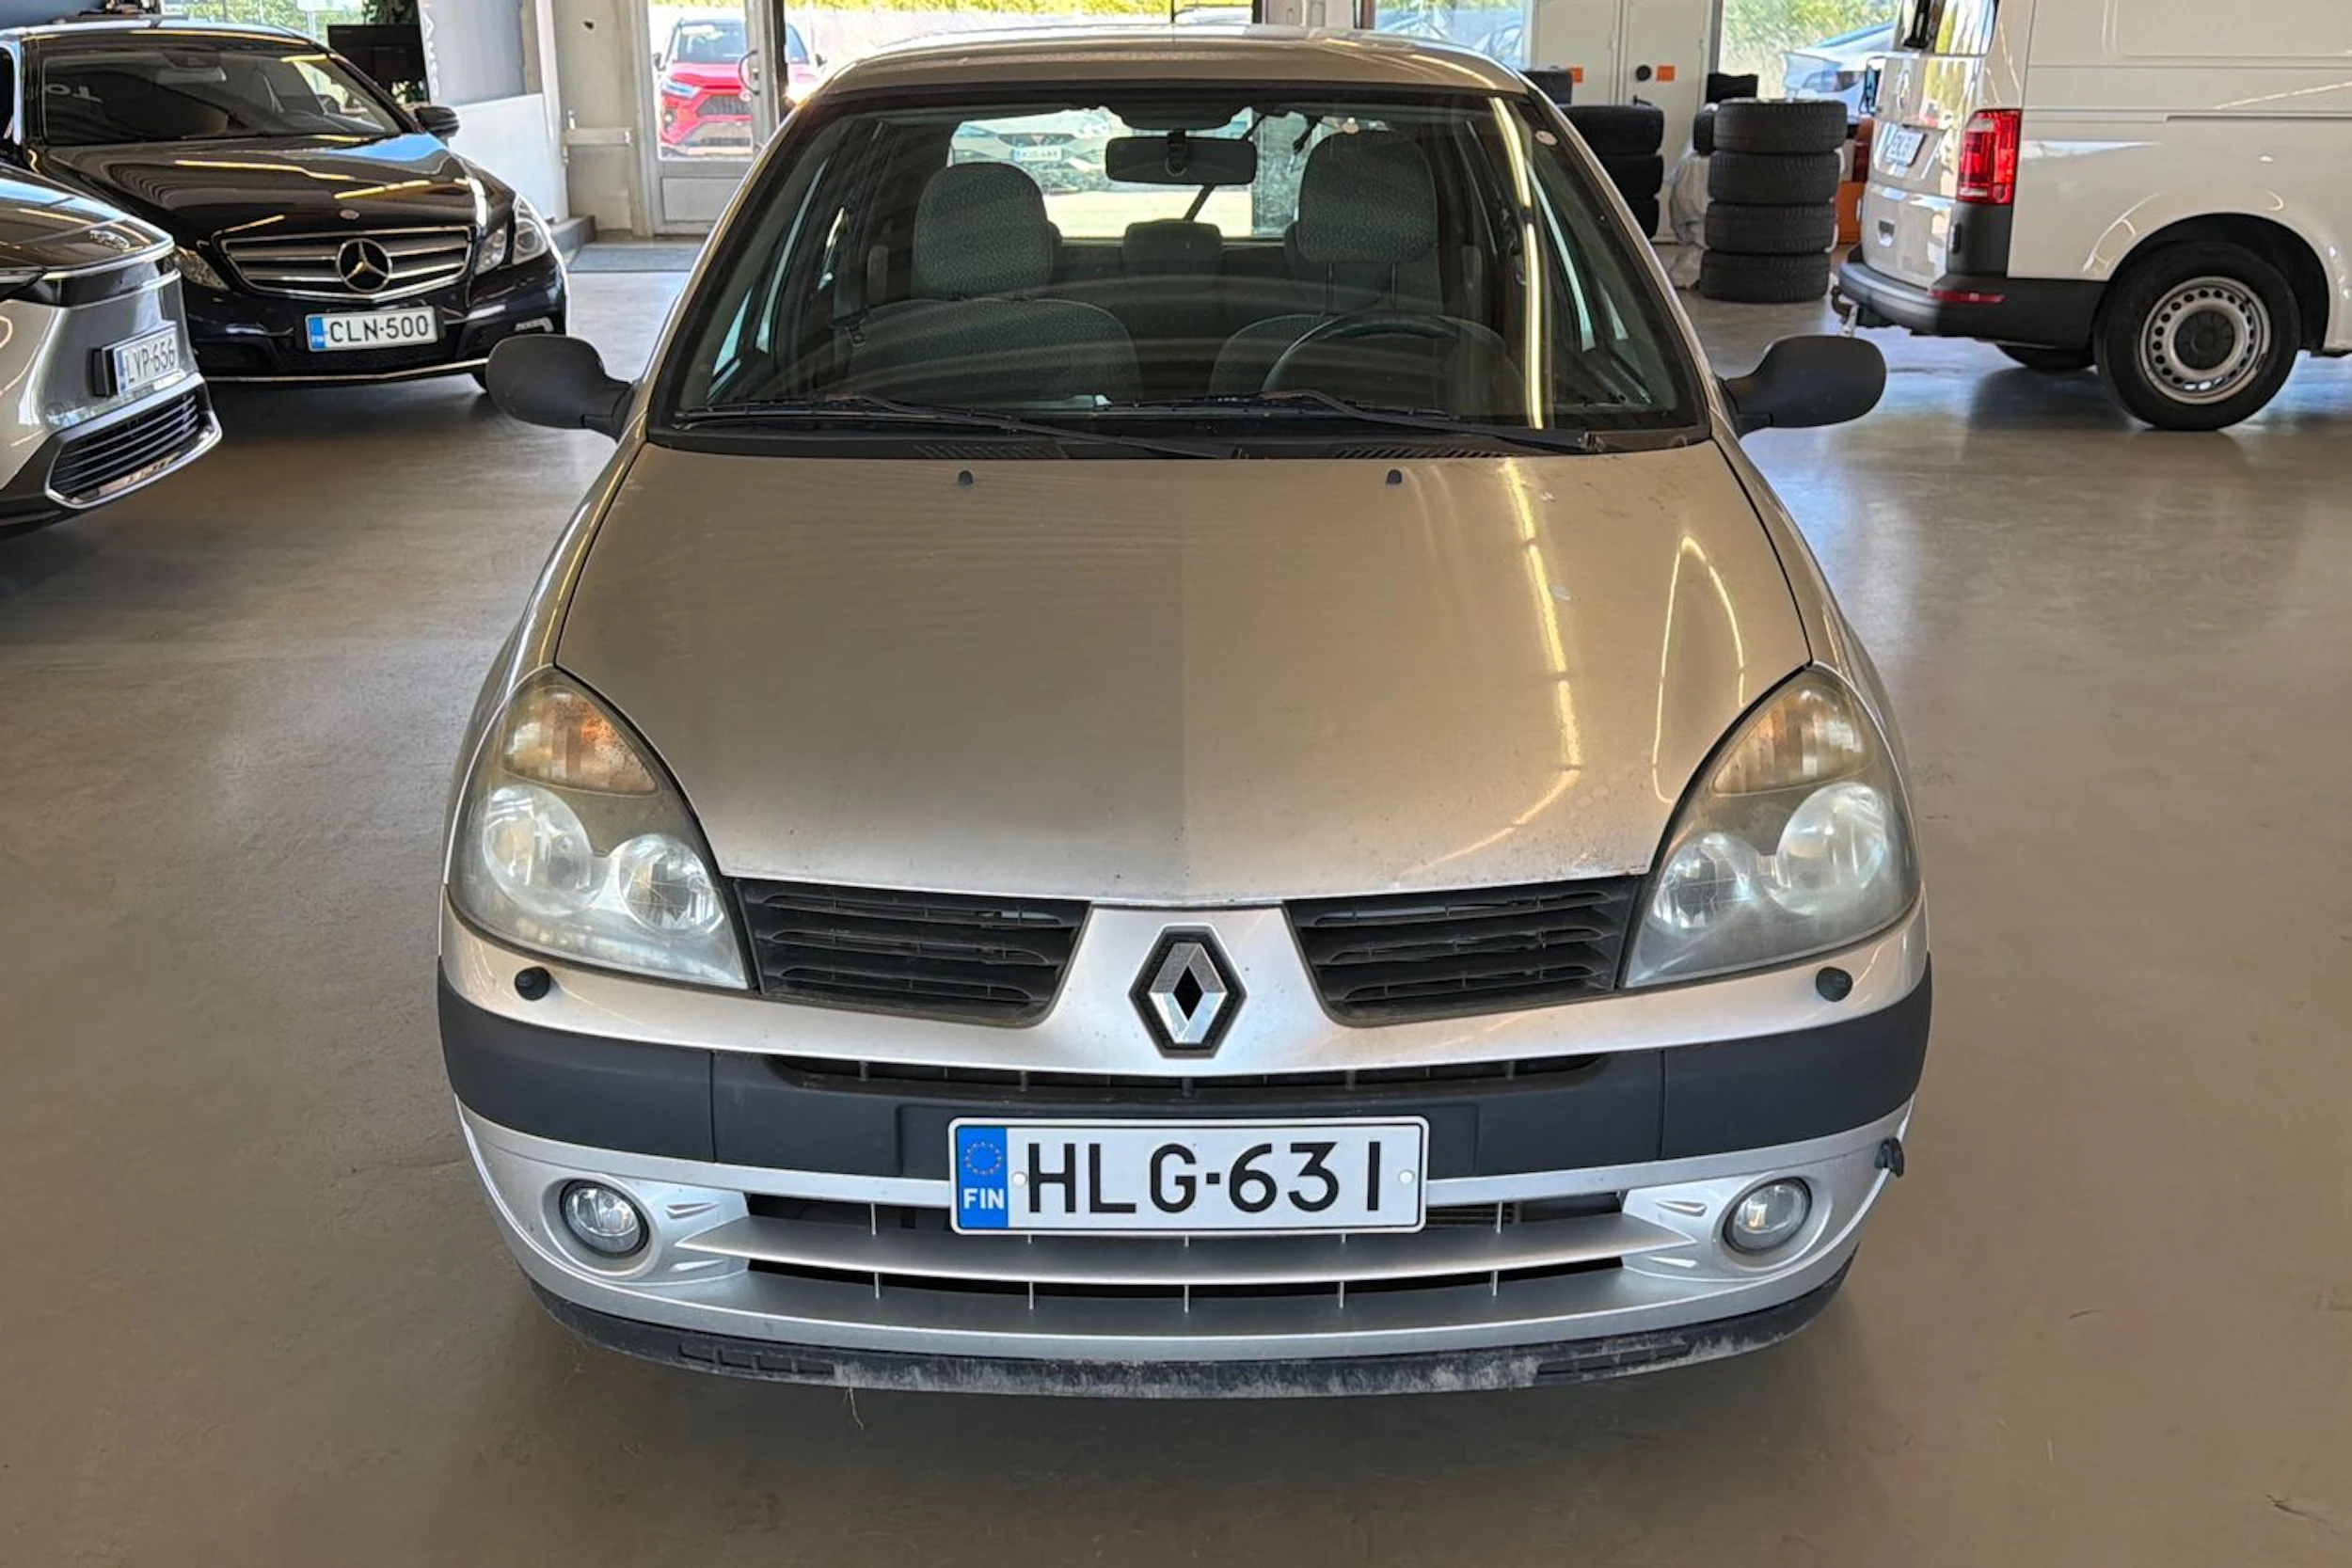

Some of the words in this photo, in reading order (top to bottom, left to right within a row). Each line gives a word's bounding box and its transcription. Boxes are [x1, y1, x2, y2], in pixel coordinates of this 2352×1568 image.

[329, 315, 429, 343] CLN-500
[1027, 1141, 1380, 1214] HLG-631
[962, 1187, 1006, 1211] FIN
